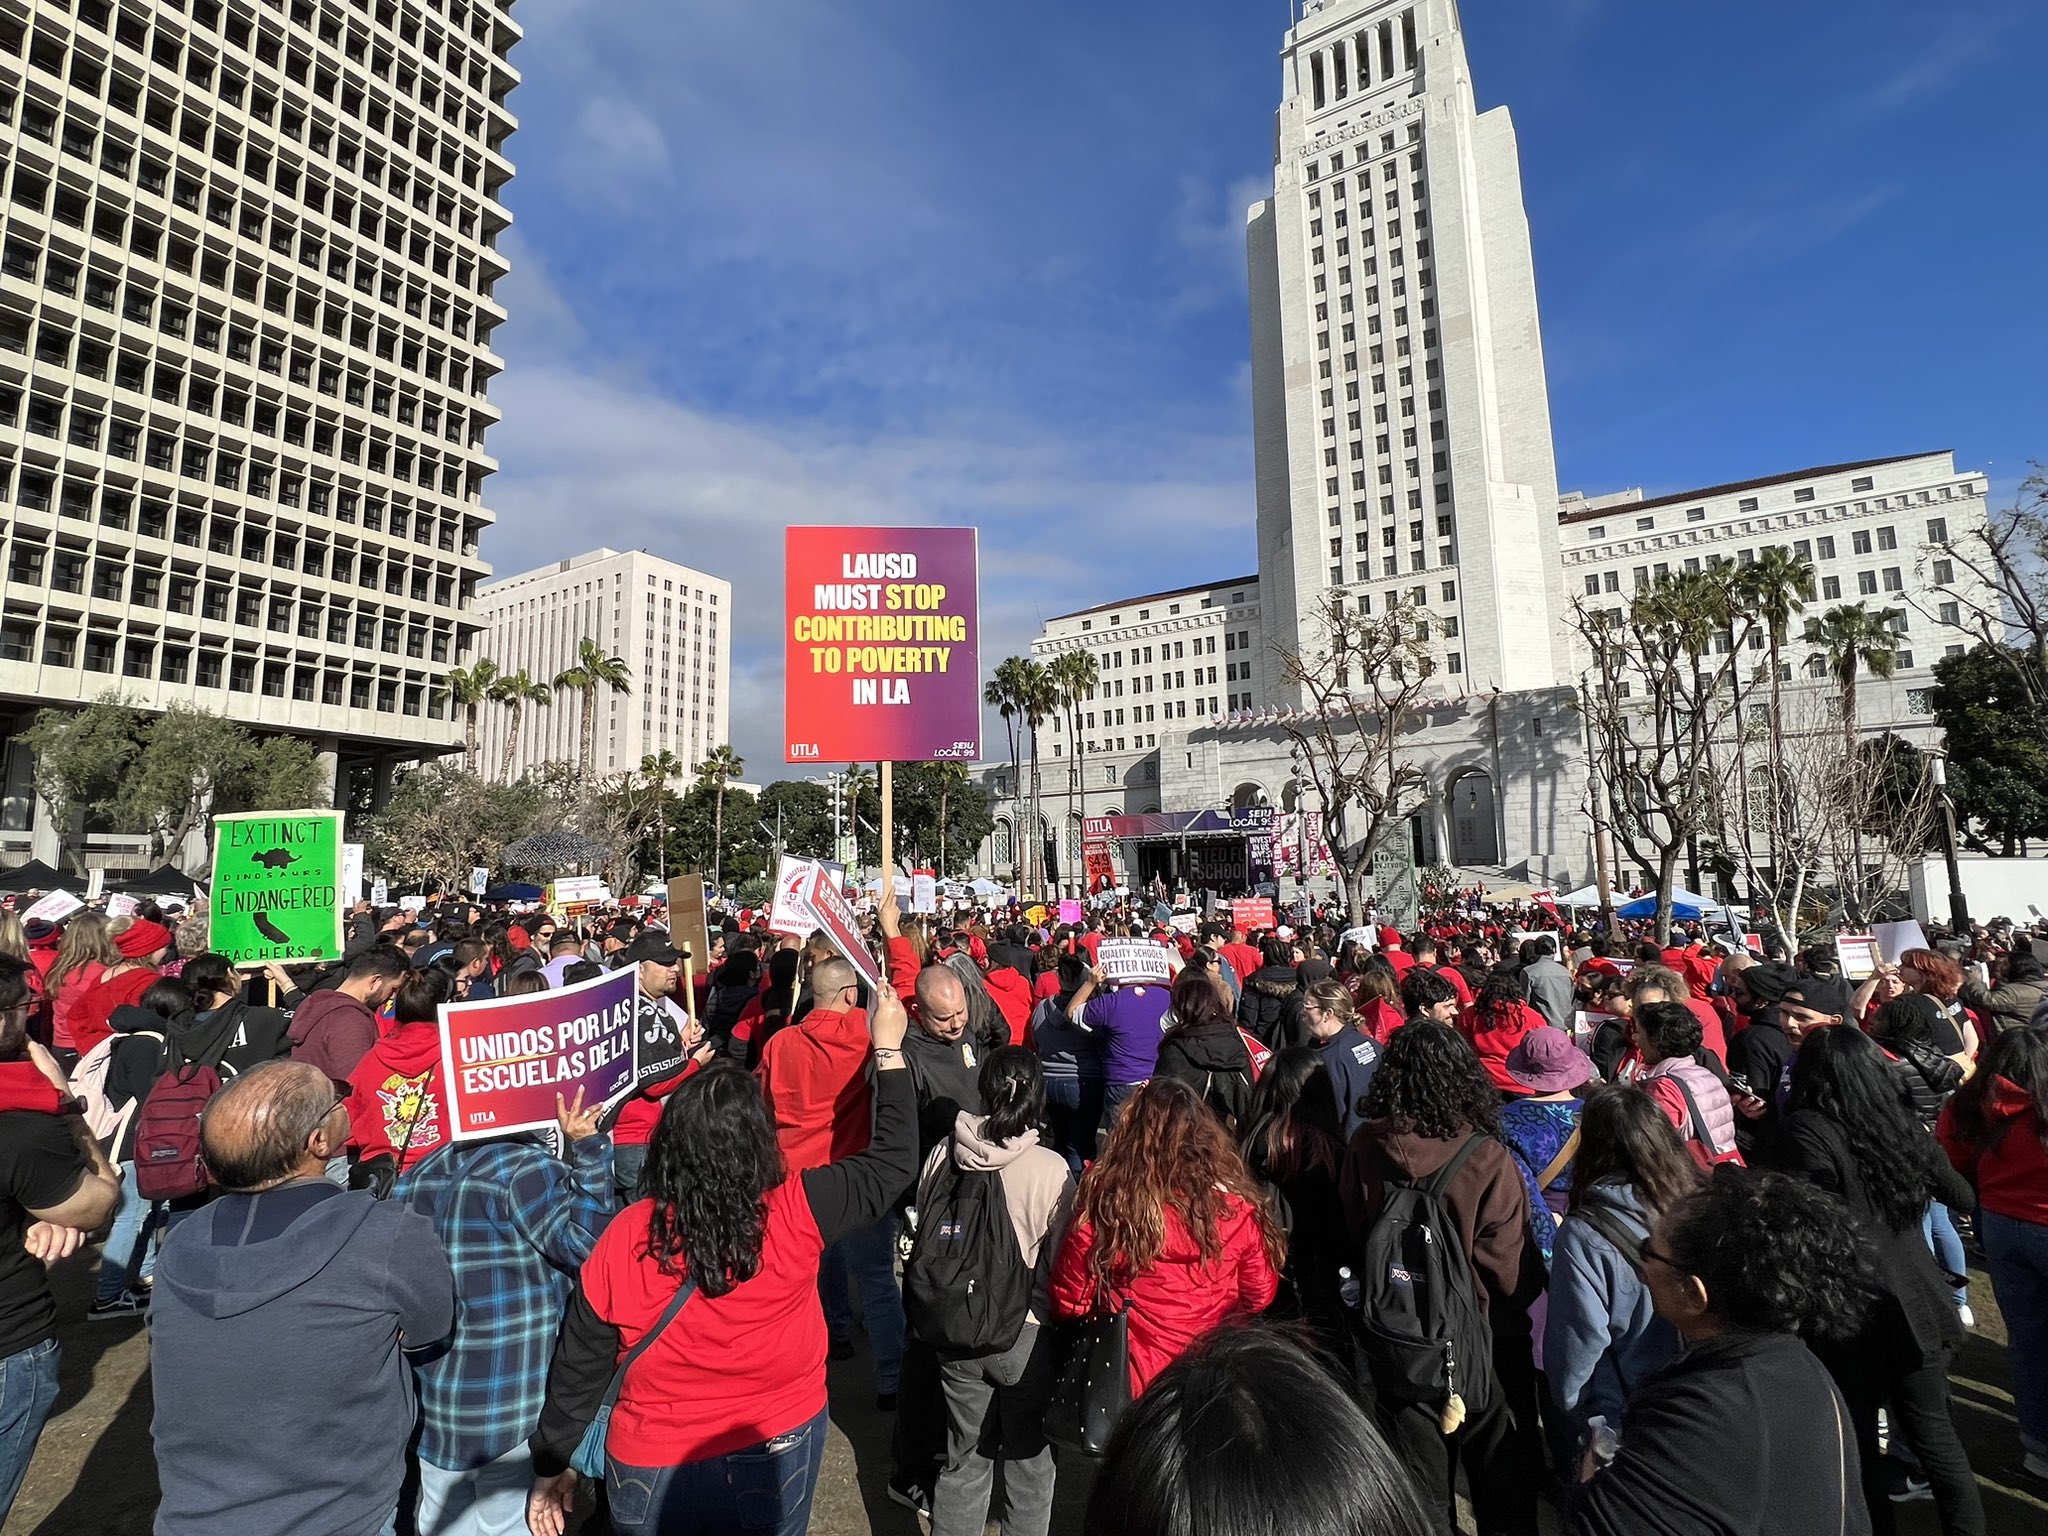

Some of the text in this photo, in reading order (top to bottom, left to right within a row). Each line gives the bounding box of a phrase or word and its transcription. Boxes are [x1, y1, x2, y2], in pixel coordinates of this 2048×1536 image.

[843, 553, 917, 579] LAUSD
[814, 584, 946, 610] MUST STOP
[794, 615, 966, 641] CONTRIBUTING
[810, 647, 951, 673] TO POVERTY
[853, 678, 910, 705] IN LA
[791, 744, 819, 757] UTLA
[934, 749, 975, 757] LOCAL 99
[953, 741, 974, 750] SEIU
[1248, 809, 1272, 818] SEIU
[1086, 819, 1112, 832] UTLA
[1229, 818, 1259, 827] LOCAL
[231, 821, 322, 847] EXTINCT
[1271, 815, 1283, 877] CELEBRATING
[1308, 812, 1319, 876] CELEBRATING
[1088, 854, 1110, 867] $4.9
[224, 869, 322, 881] DINOSAURS
[221, 886, 336, 915] ENDANGERED
[775, 919, 797, 927] MENDEZ
[798, 921, 812, 929] HIGH
[1100, 948, 1130, 960] QUALITY
[1102, 960, 1168, 975] BETTER LIVES!
[459, 998, 631, 1064] UNIDOS POR LAS
[463, 1029, 631, 1094] ESCUELAS DE LA
[470, 1111, 496, 1123] UTLA
